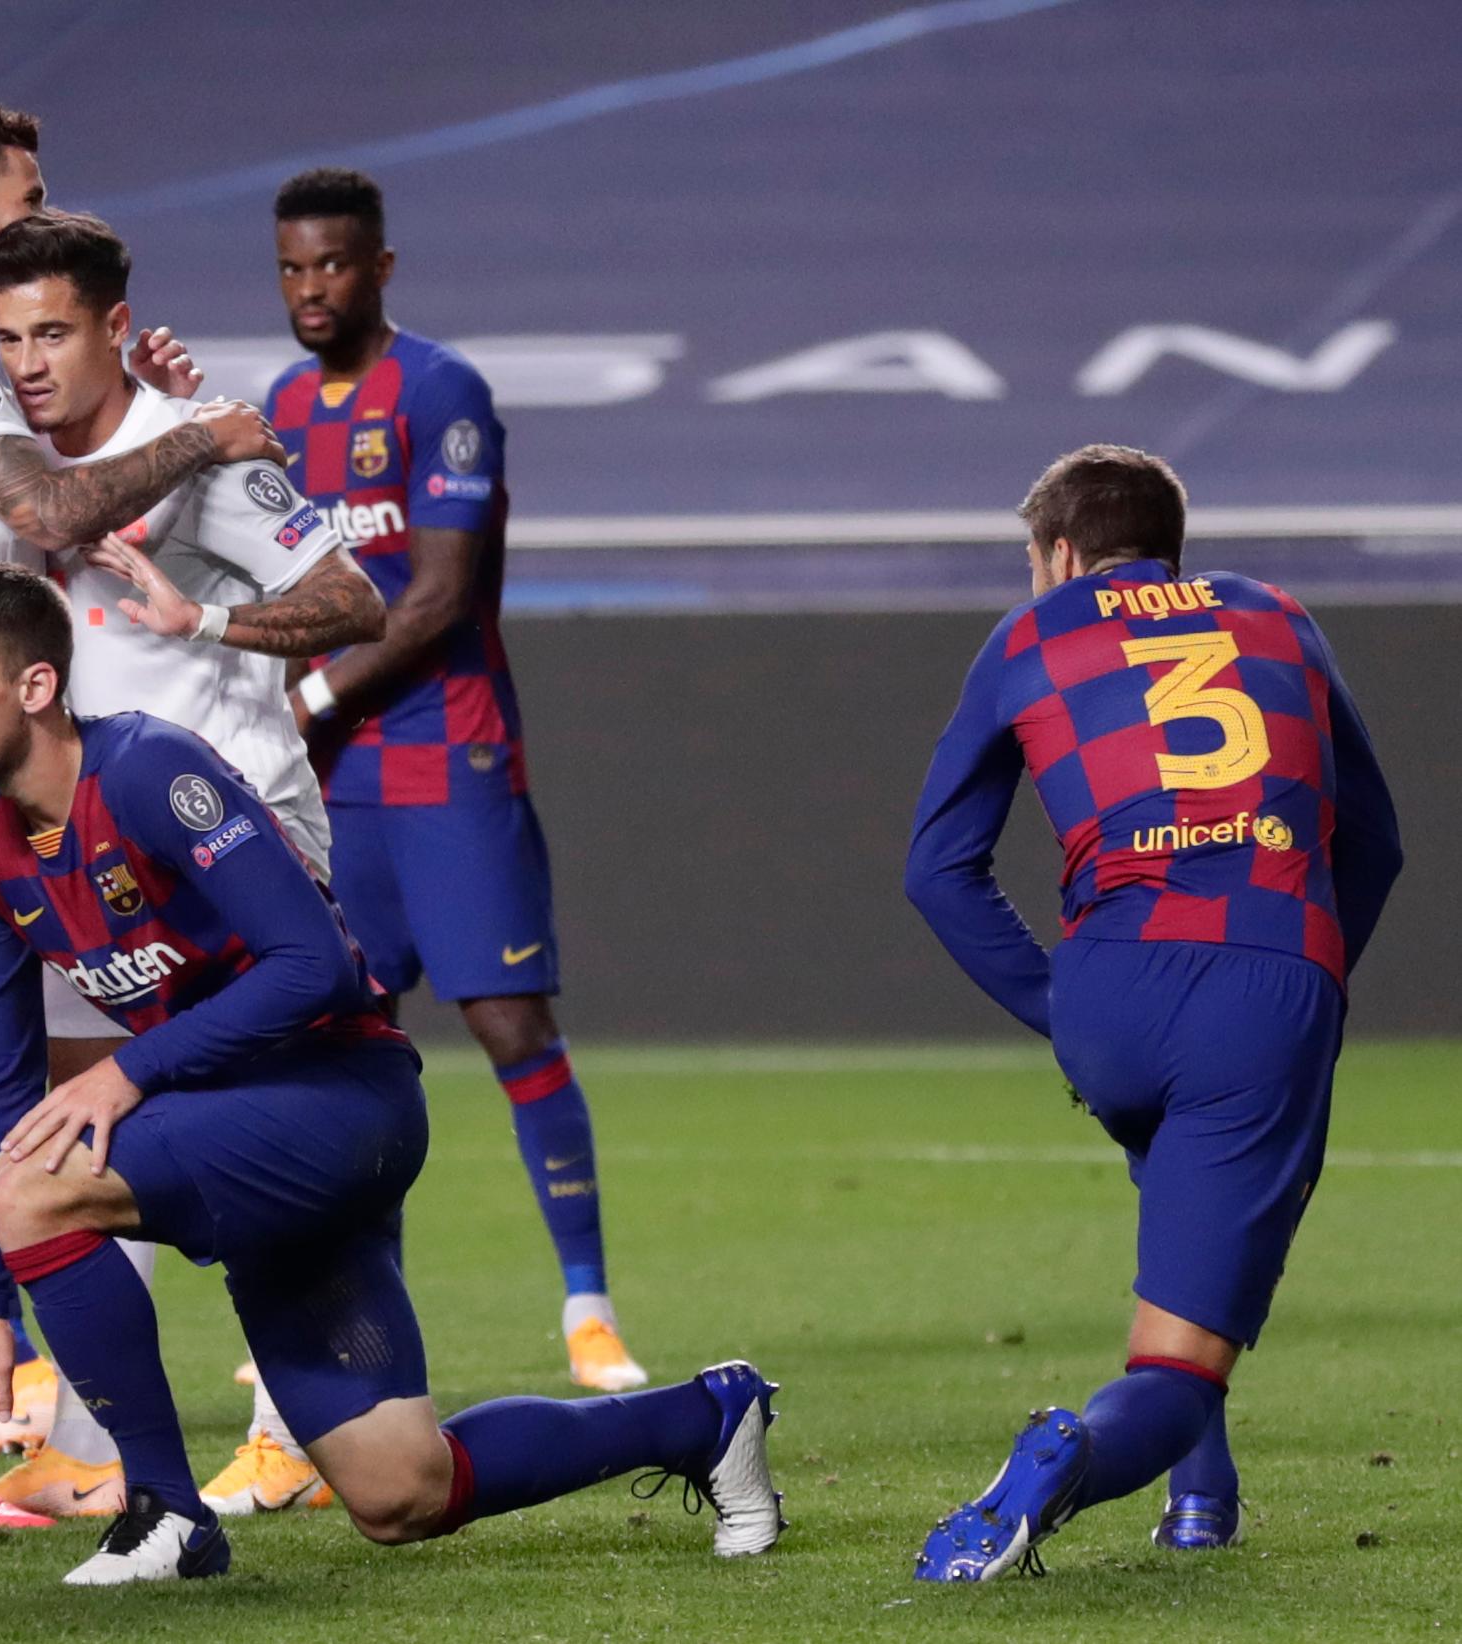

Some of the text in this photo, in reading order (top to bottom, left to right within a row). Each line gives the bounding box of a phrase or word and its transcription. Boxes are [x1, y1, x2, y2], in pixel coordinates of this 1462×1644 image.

[1095, 577, 1223, 621] PIQUÉ
[1120, 631, 1271, 791] 3
[194, 800, 208, 815] 5
[1133, 812, 1249, 852] unicef
